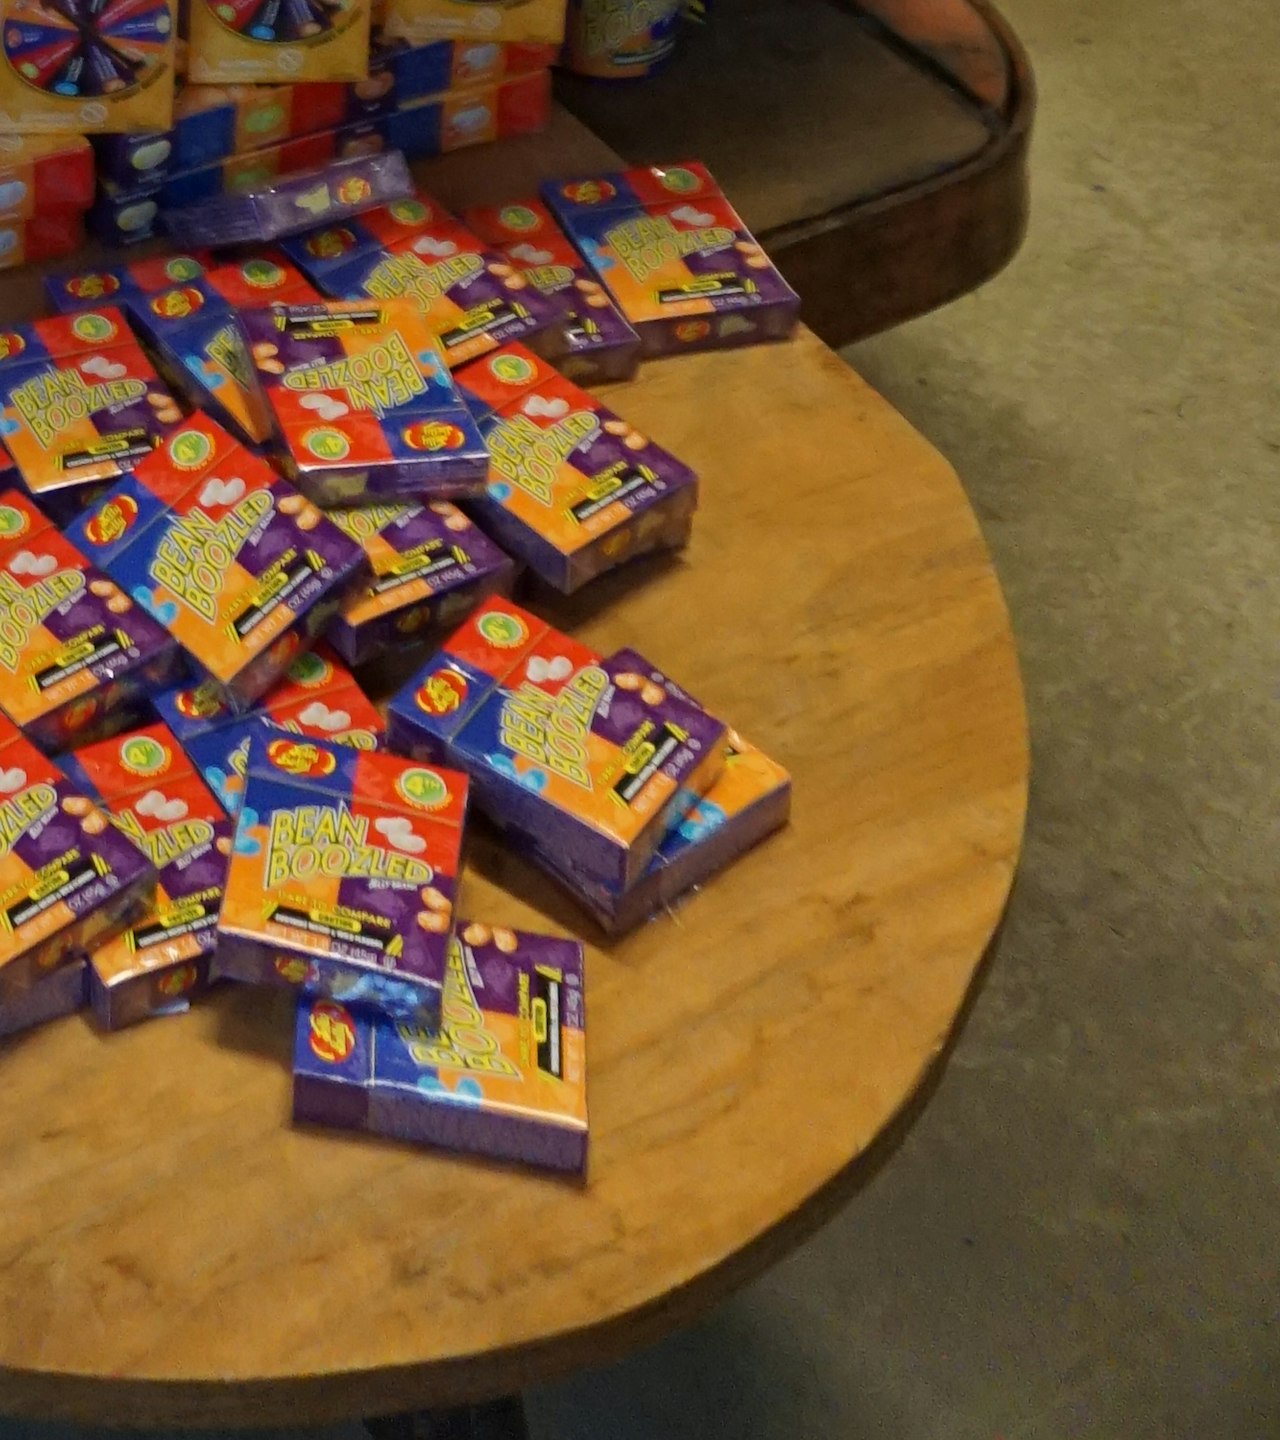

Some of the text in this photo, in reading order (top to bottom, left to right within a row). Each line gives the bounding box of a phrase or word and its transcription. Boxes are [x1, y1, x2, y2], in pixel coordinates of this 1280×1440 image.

[24, 379, 147, 451] BOOZLED
[150, 505, 217, 596] BEAN
[183, 488, 276, 626] BOOZLED
[271, 797, 370, 852] BEAN
[264, 842, 434, 892] BOOZLED
